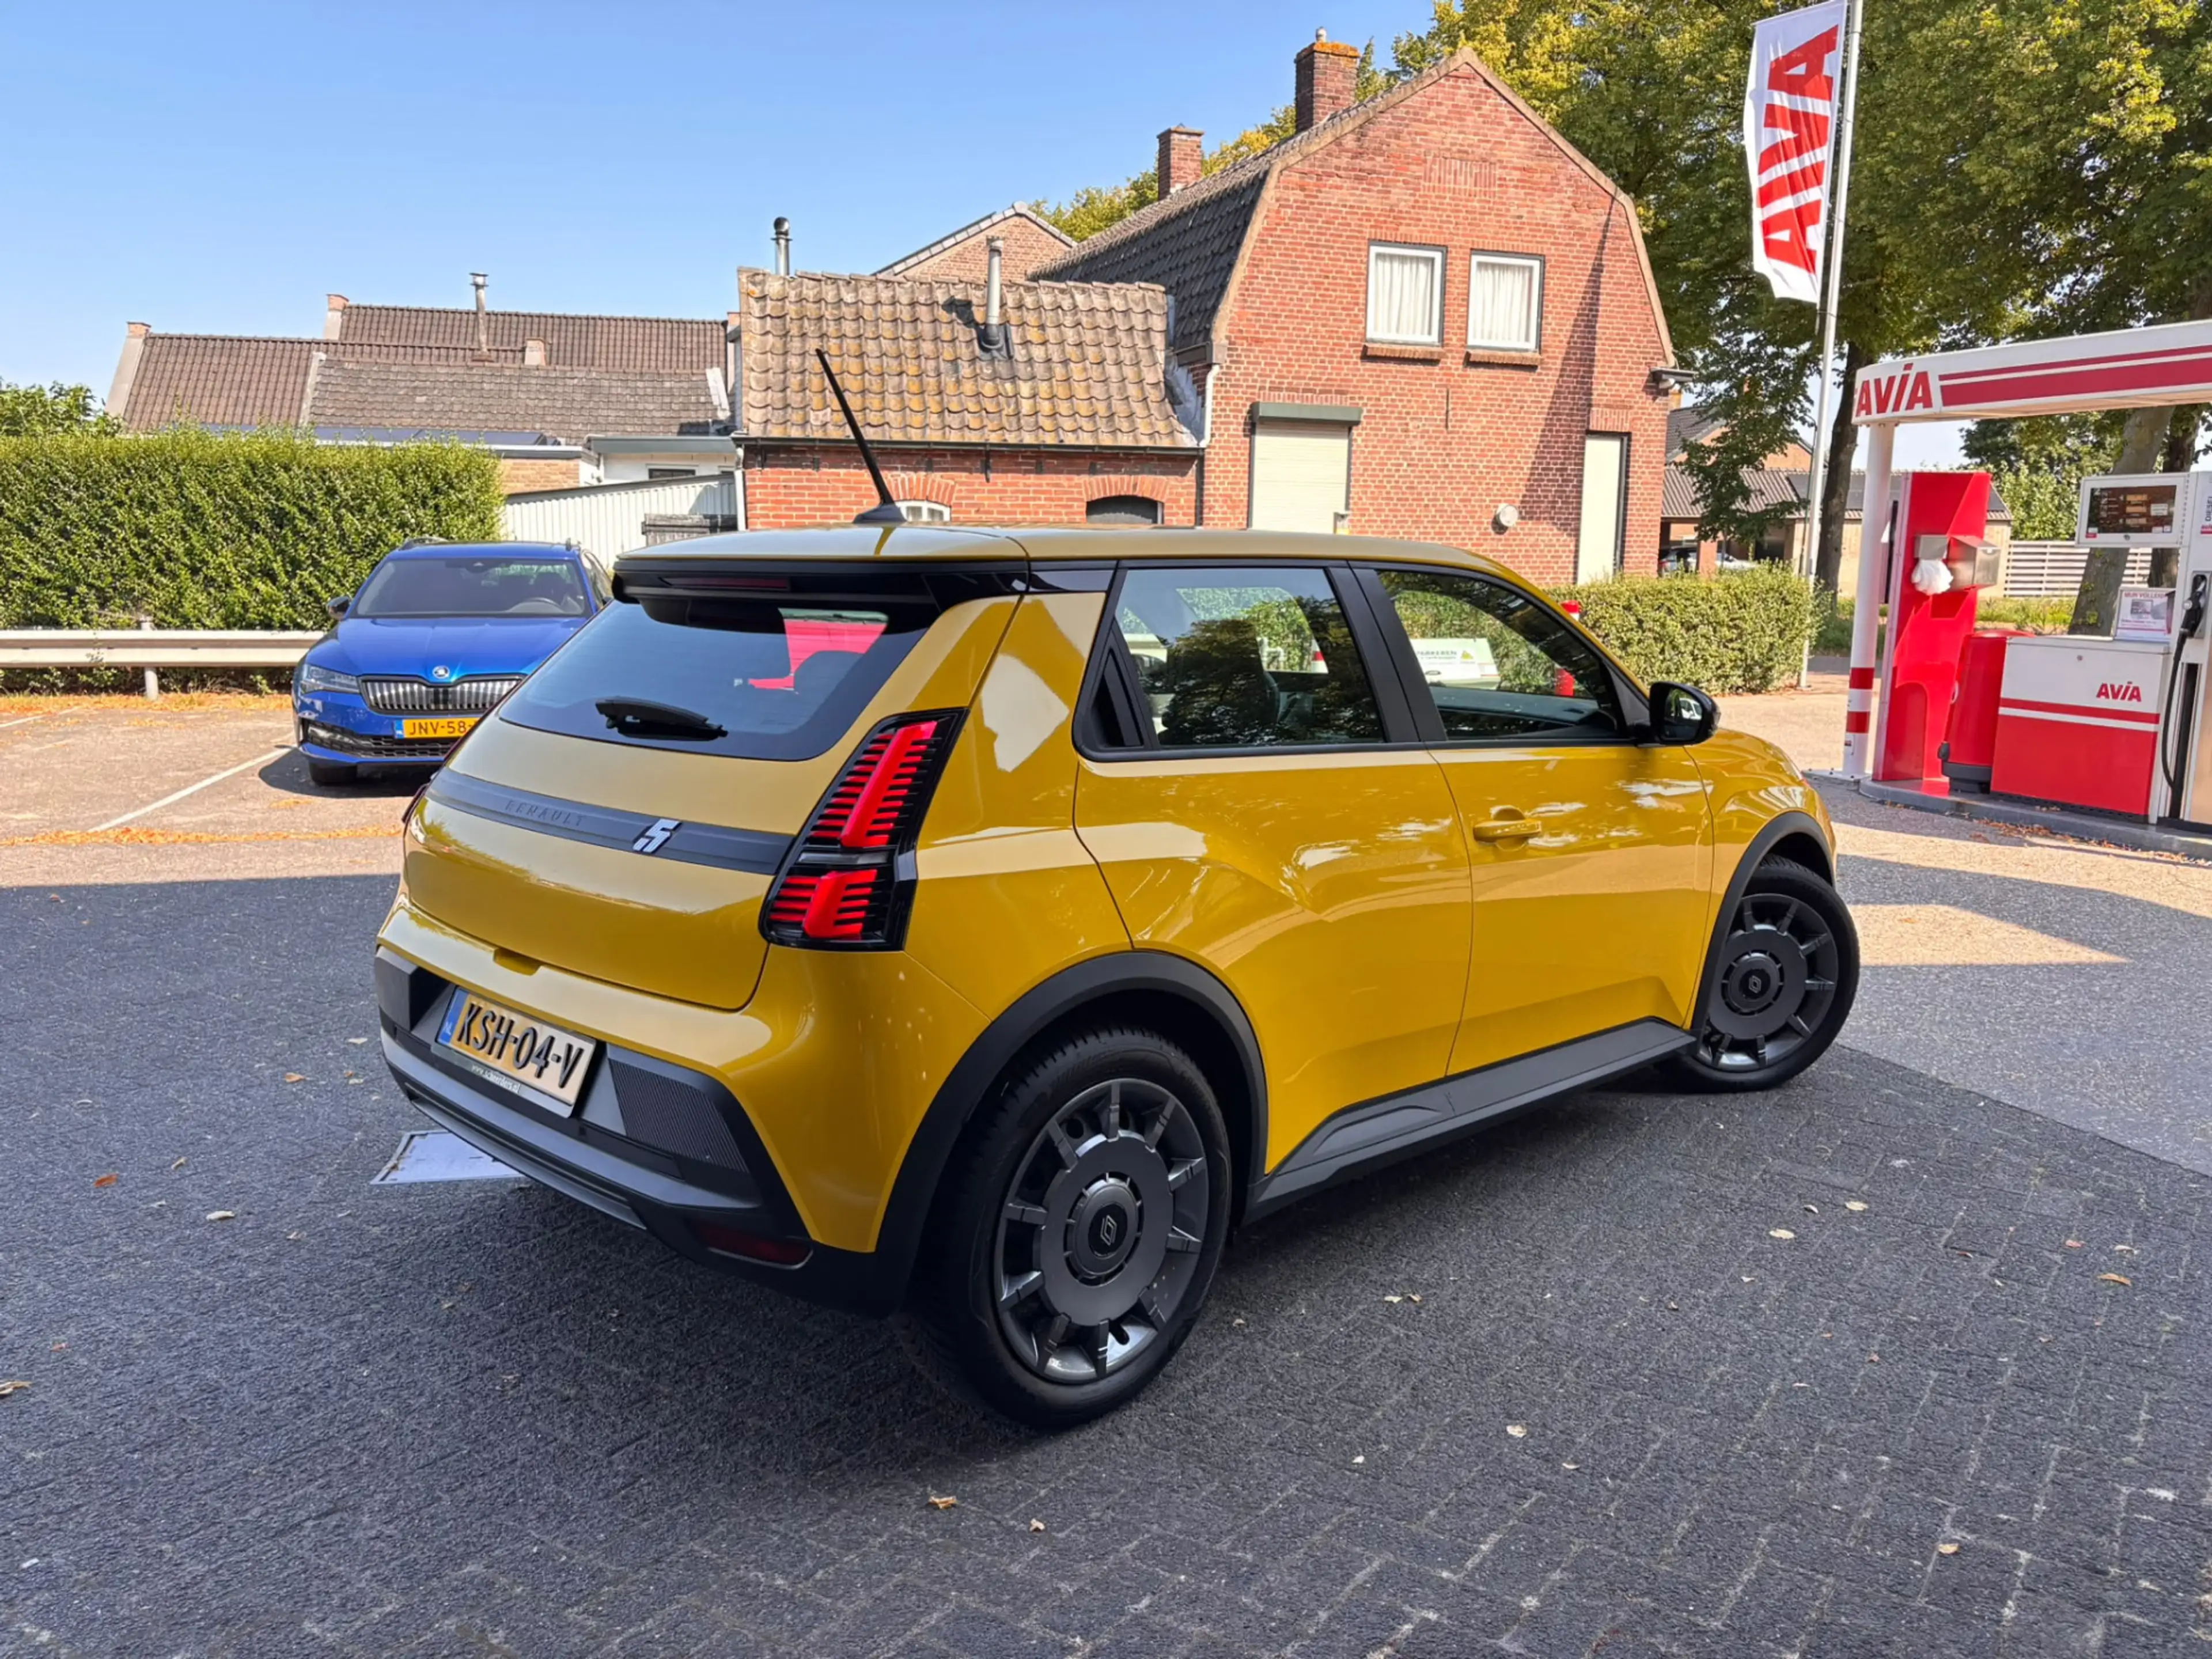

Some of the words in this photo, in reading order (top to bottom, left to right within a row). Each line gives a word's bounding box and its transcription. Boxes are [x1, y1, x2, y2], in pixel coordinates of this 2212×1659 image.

[1756, 24, 1839, 275] AVIA
[410, 720, 478, 735] JNV-58-
[505, 800, 586, 827] RENAULT
[457, 1002, 585, 1089] KSH-04-V
